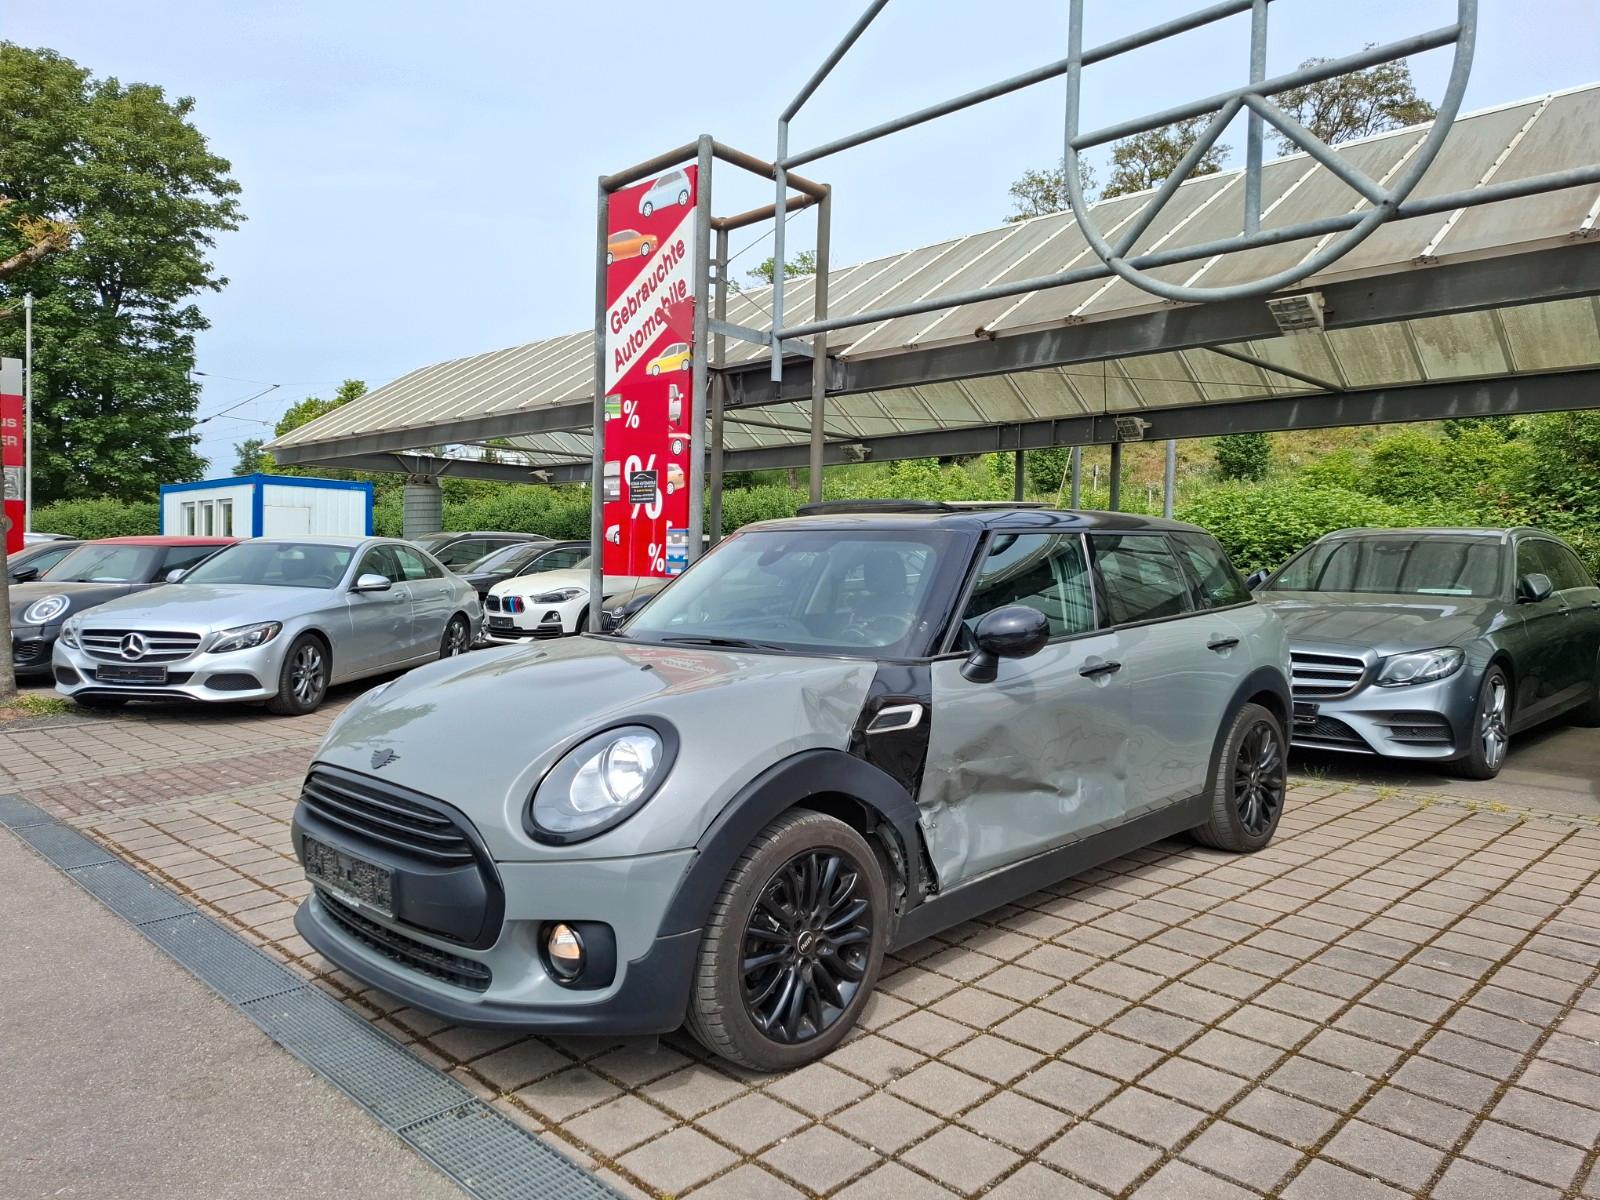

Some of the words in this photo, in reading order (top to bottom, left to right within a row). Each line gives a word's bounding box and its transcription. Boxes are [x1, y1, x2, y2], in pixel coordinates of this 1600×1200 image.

[610, 240, 685, 334] Gebrauchte
[623, 399, 640, 429] %
[648, 543, 665, 572] %
